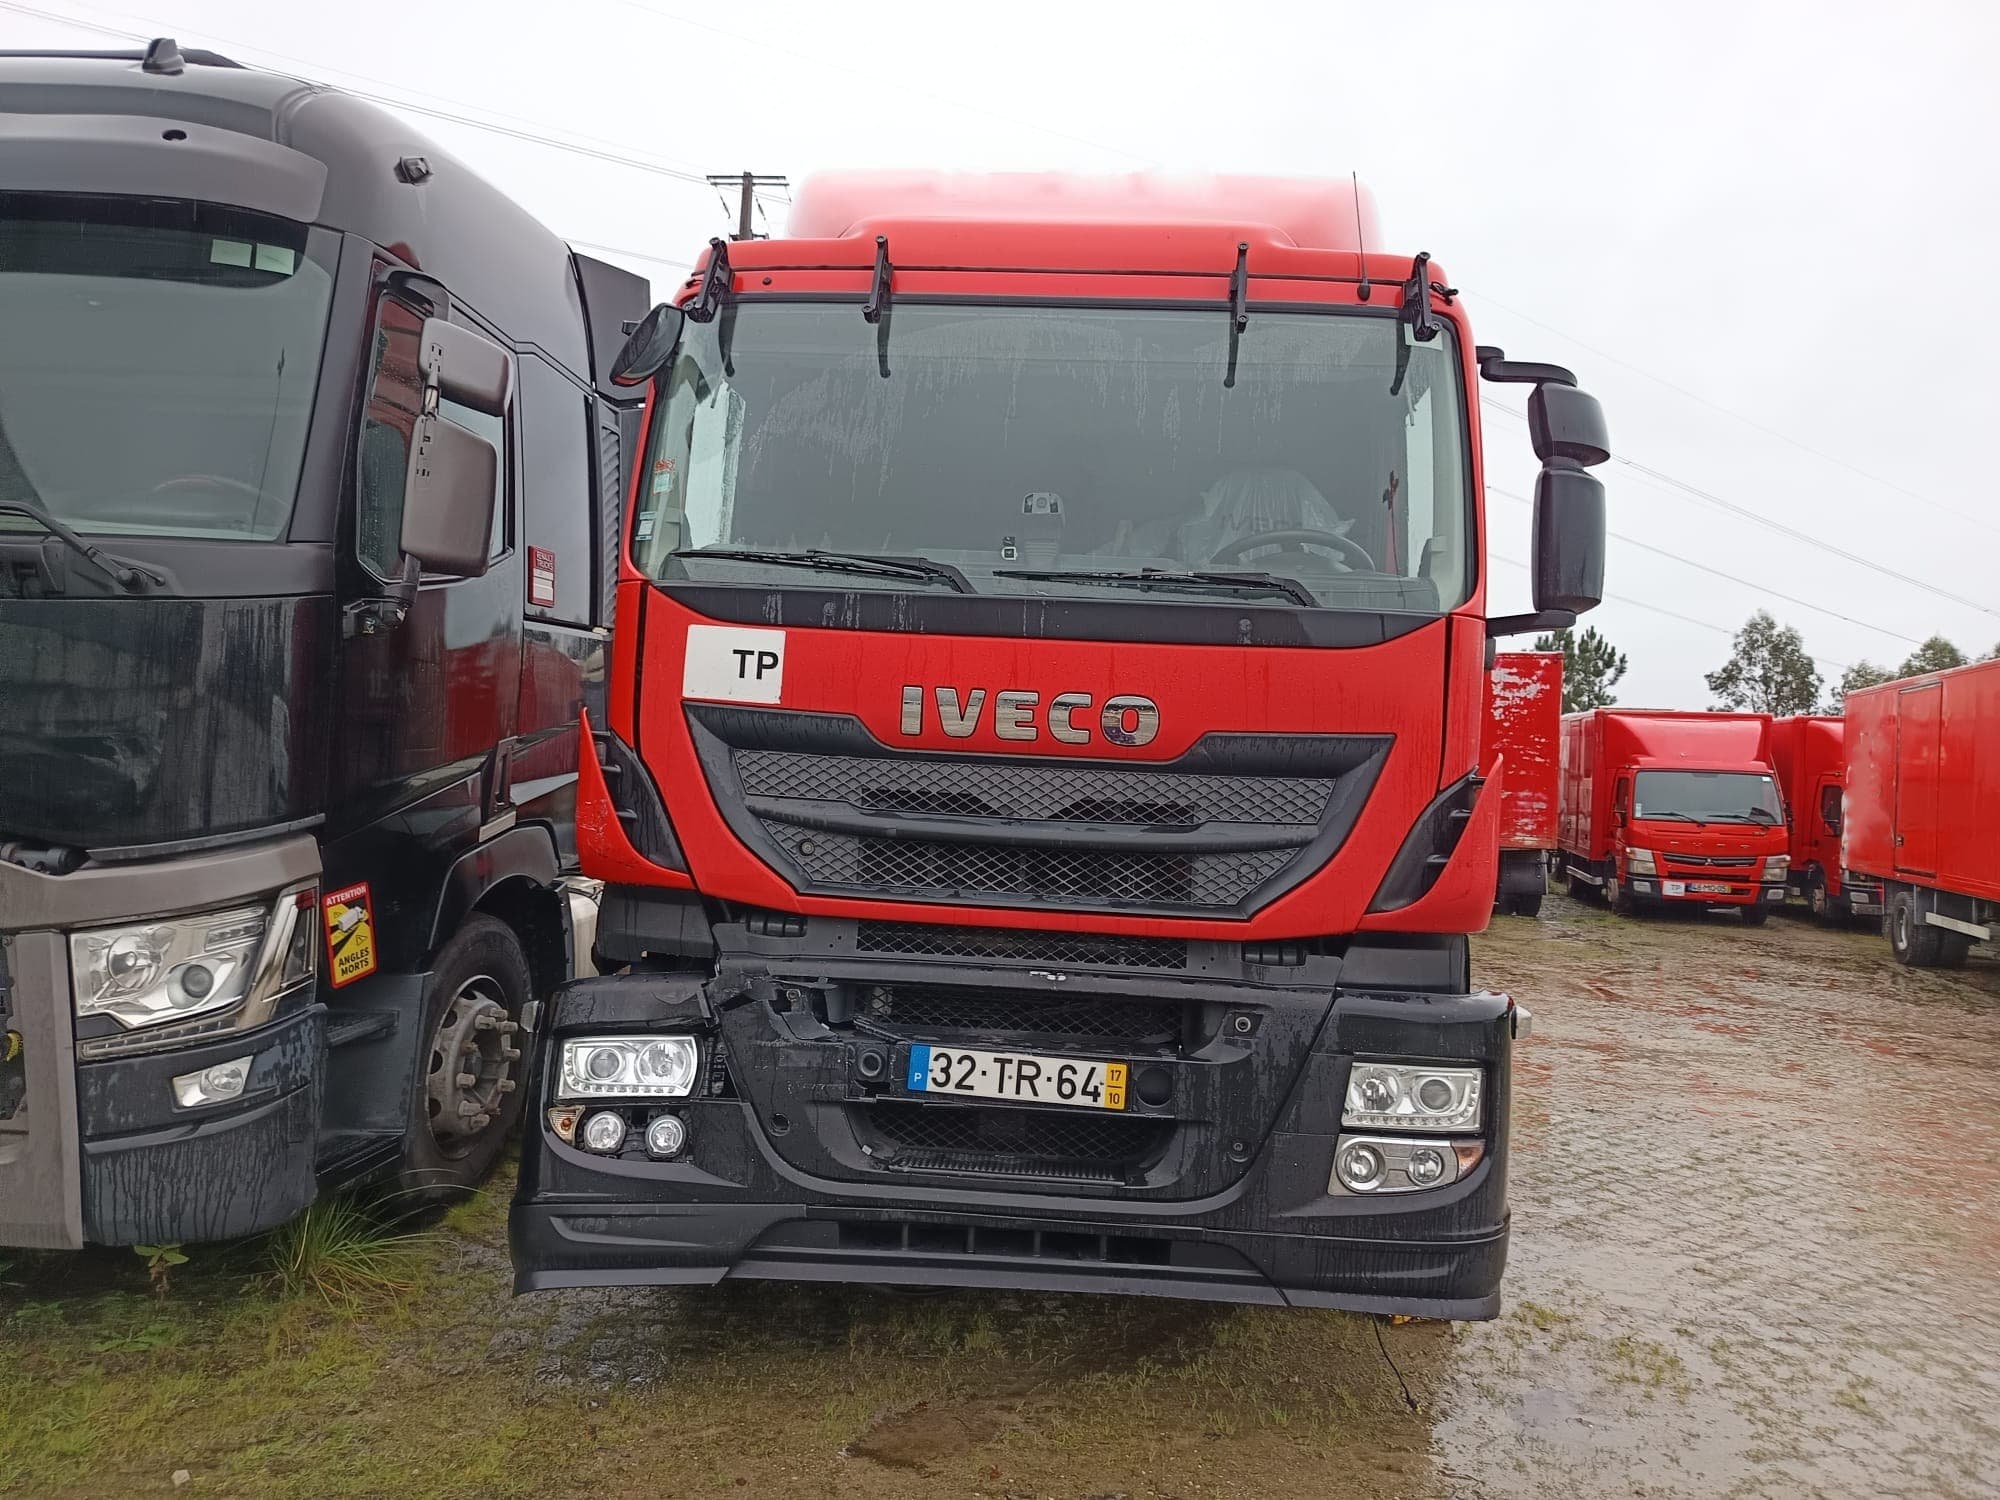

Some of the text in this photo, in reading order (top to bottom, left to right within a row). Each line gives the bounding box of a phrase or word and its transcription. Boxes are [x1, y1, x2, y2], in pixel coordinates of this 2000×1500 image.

[732, 648, 780, 681] TP
[900, 685, 1160, 746] IVECO
[326, 885, 367, 906] ATTENTION
[338, 947, 370, 967] ANGLES
[340, 957, 370, 977] MORTS
[913, 1072, 922, 1083] P
[1110, 1069, 1122, 1082] 17
[1108, 1092, 1120, 1105] 10
